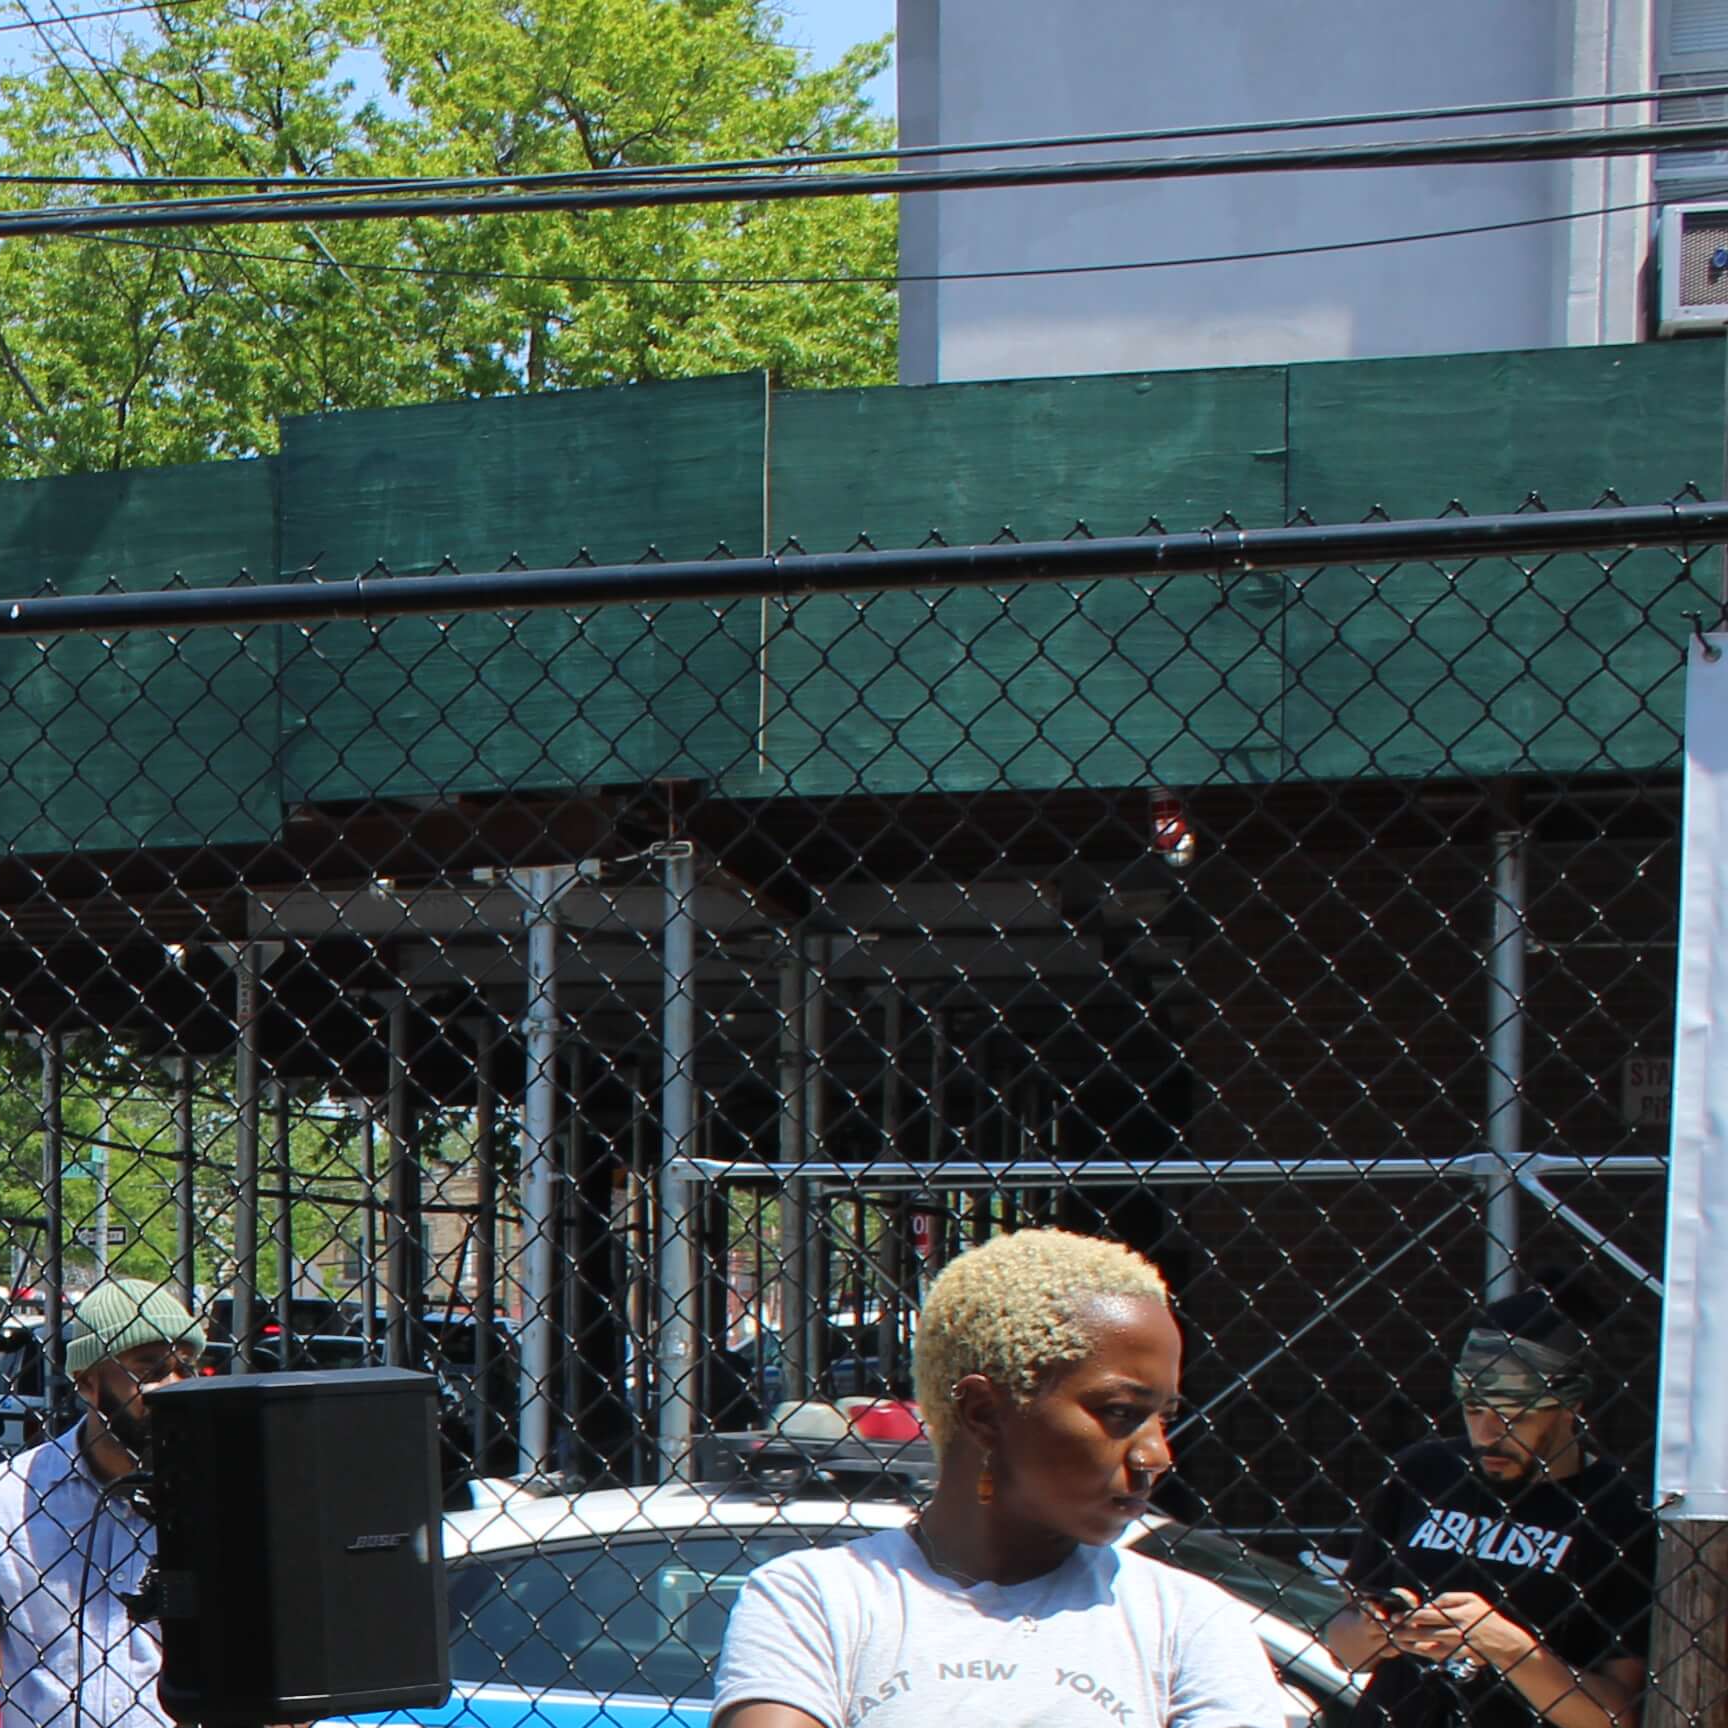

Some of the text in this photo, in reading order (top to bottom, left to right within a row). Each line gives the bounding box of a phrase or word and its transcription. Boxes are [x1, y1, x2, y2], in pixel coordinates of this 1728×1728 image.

[845, 1660, 1134, 1728] EAST NEW YORK
